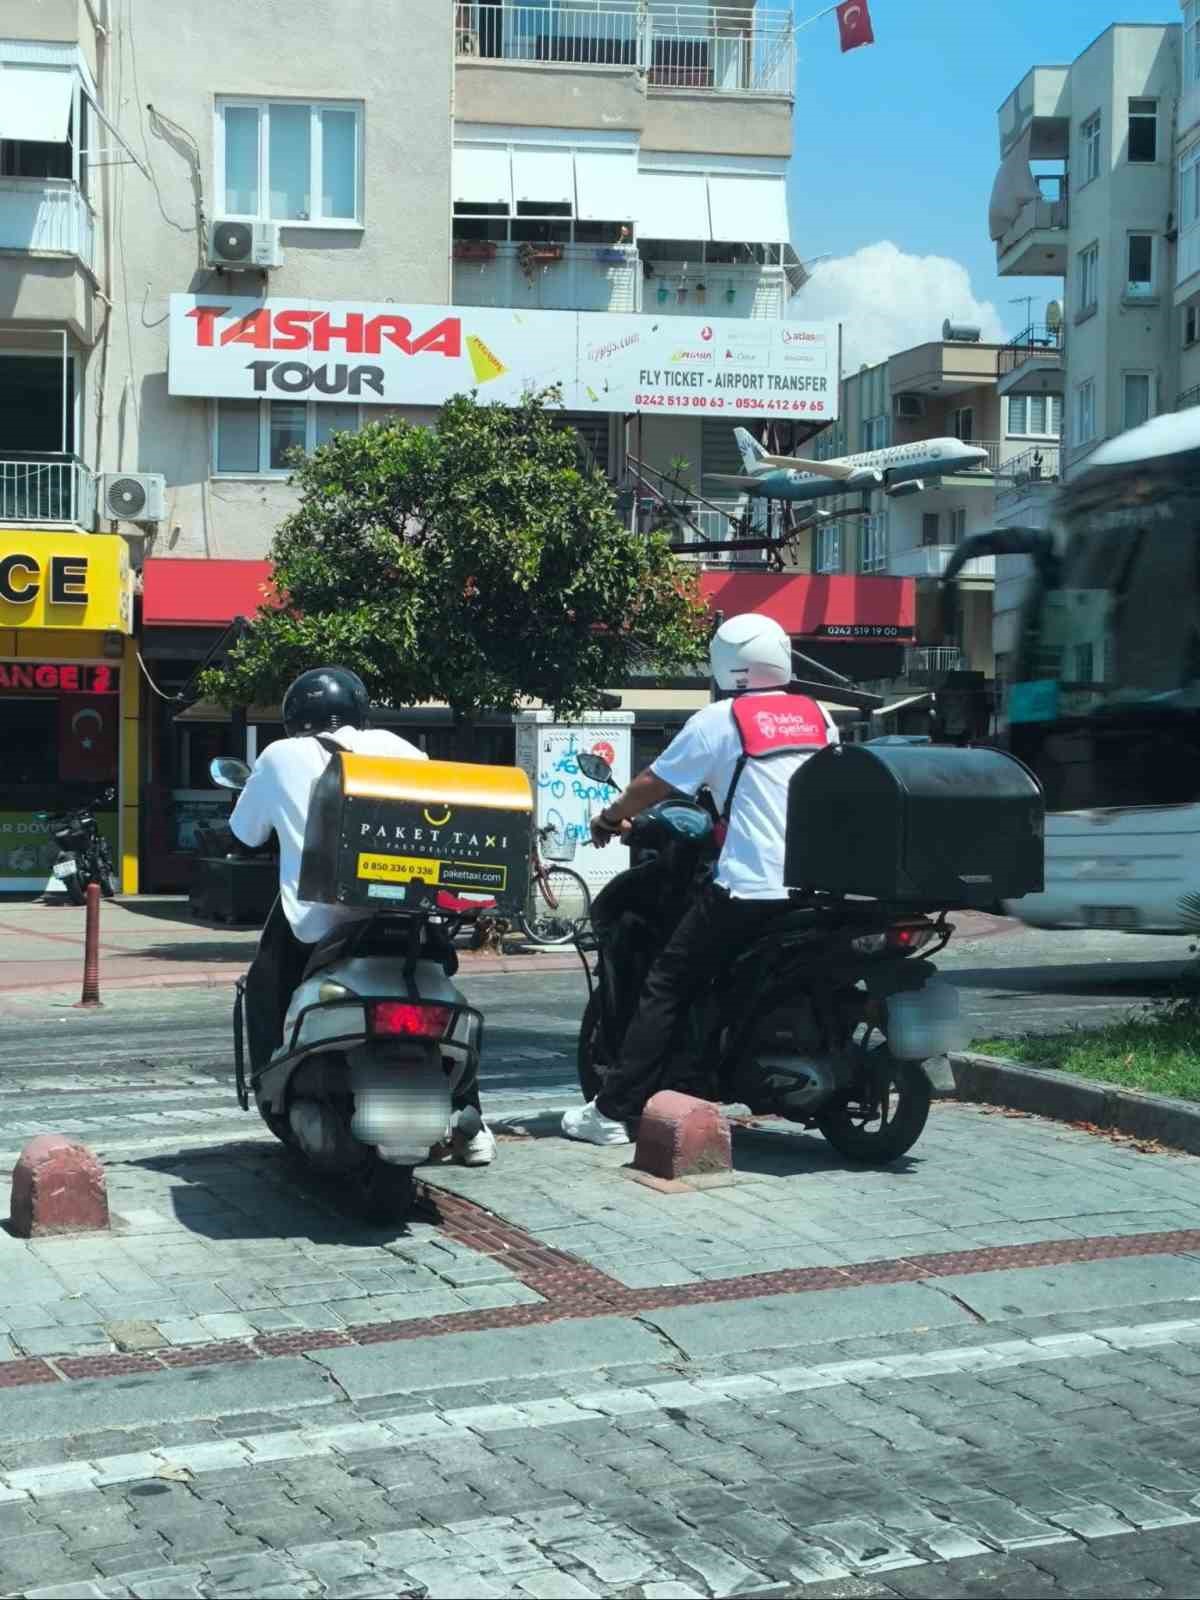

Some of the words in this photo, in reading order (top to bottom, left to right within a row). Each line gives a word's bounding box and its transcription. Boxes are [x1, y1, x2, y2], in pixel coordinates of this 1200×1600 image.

[184, 305, 461, 358] TASHRA
[245, 360, 385, 396] TOUR
[639, 370, 661, 386] FLY
[664, 371, 704, 387] TICKET
[714, 373, 765, 389] AIRPORT
[767, 375, 828, 392] TRANSFER
[634, 394, 665, 406] 0242
[667, 396, 690, 407] 513
[692, 397, 707, 408] 00
[710, 398, 725, 408] 63
[735, 398, 765, 409] 0534
[767, 400, 790, 411] 412
[792, 400, 807, 411] 69
[809, 401, 825, 412] 65
[360, 823, 440, 842] PAKET
[453, 831, 508, 849] TAXI
[442, 868, 502, 882] pakettaxi.com
